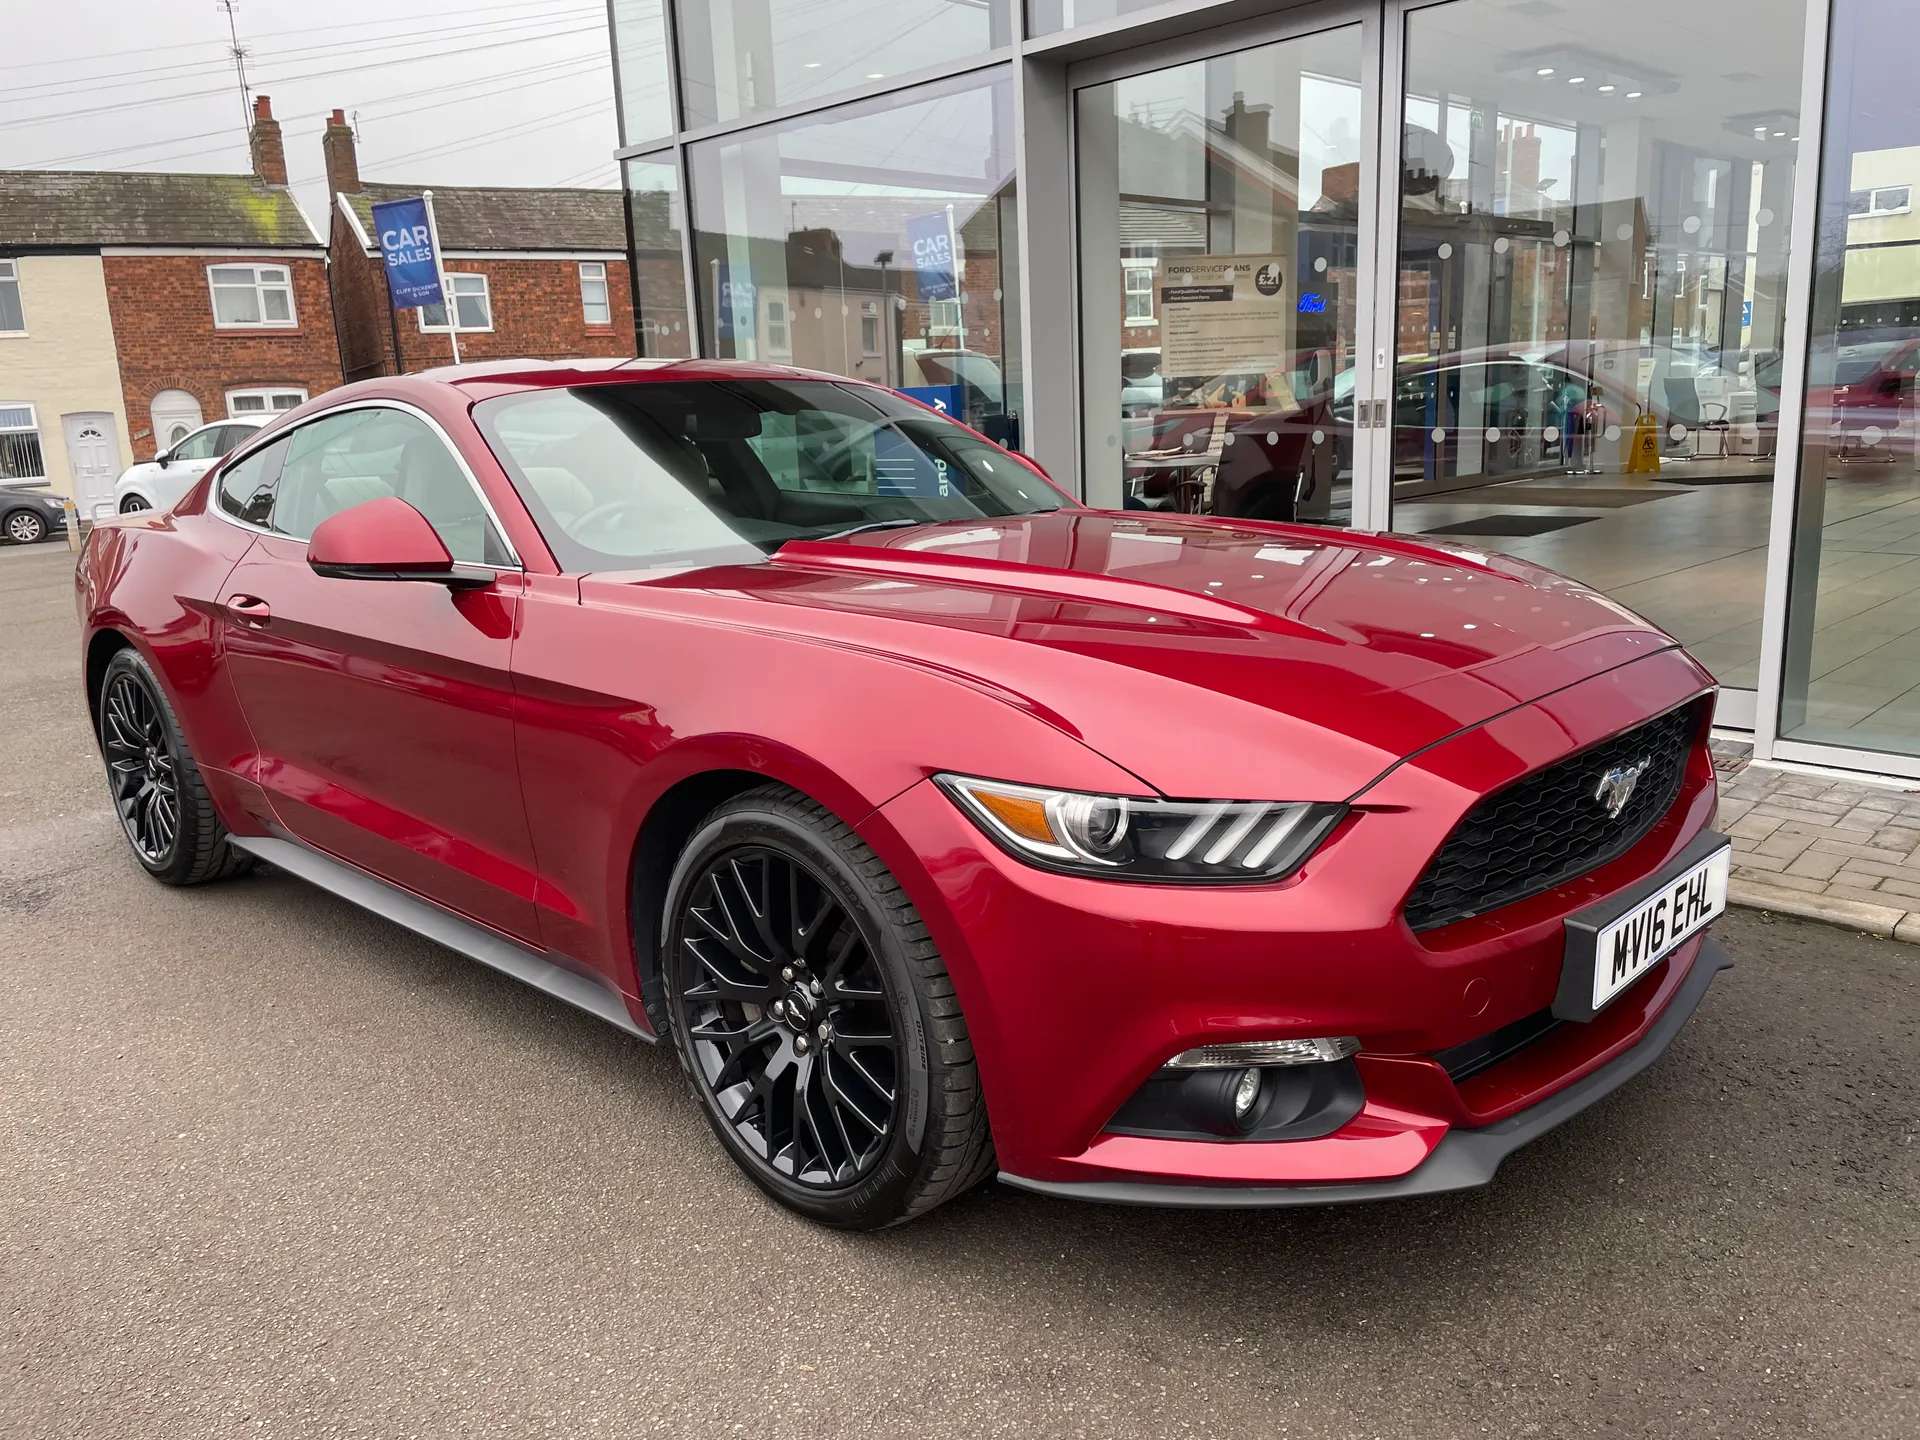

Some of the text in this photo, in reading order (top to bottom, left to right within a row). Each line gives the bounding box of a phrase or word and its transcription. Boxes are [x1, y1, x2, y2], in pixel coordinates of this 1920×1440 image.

[382, 225, 430, 251] CAR
[913, 234, 949, 256] CAR
[387, 247, 432, 267] SALES
[916, 251, 952, 269] SALES
[1168, 264, 1251, 275] FORDSERVICEPANS
[1296, 292, 1328, 313] Ford
[934, 458, 949, 497] and
[1611, 867, 1713, 986] MV16 EHL
